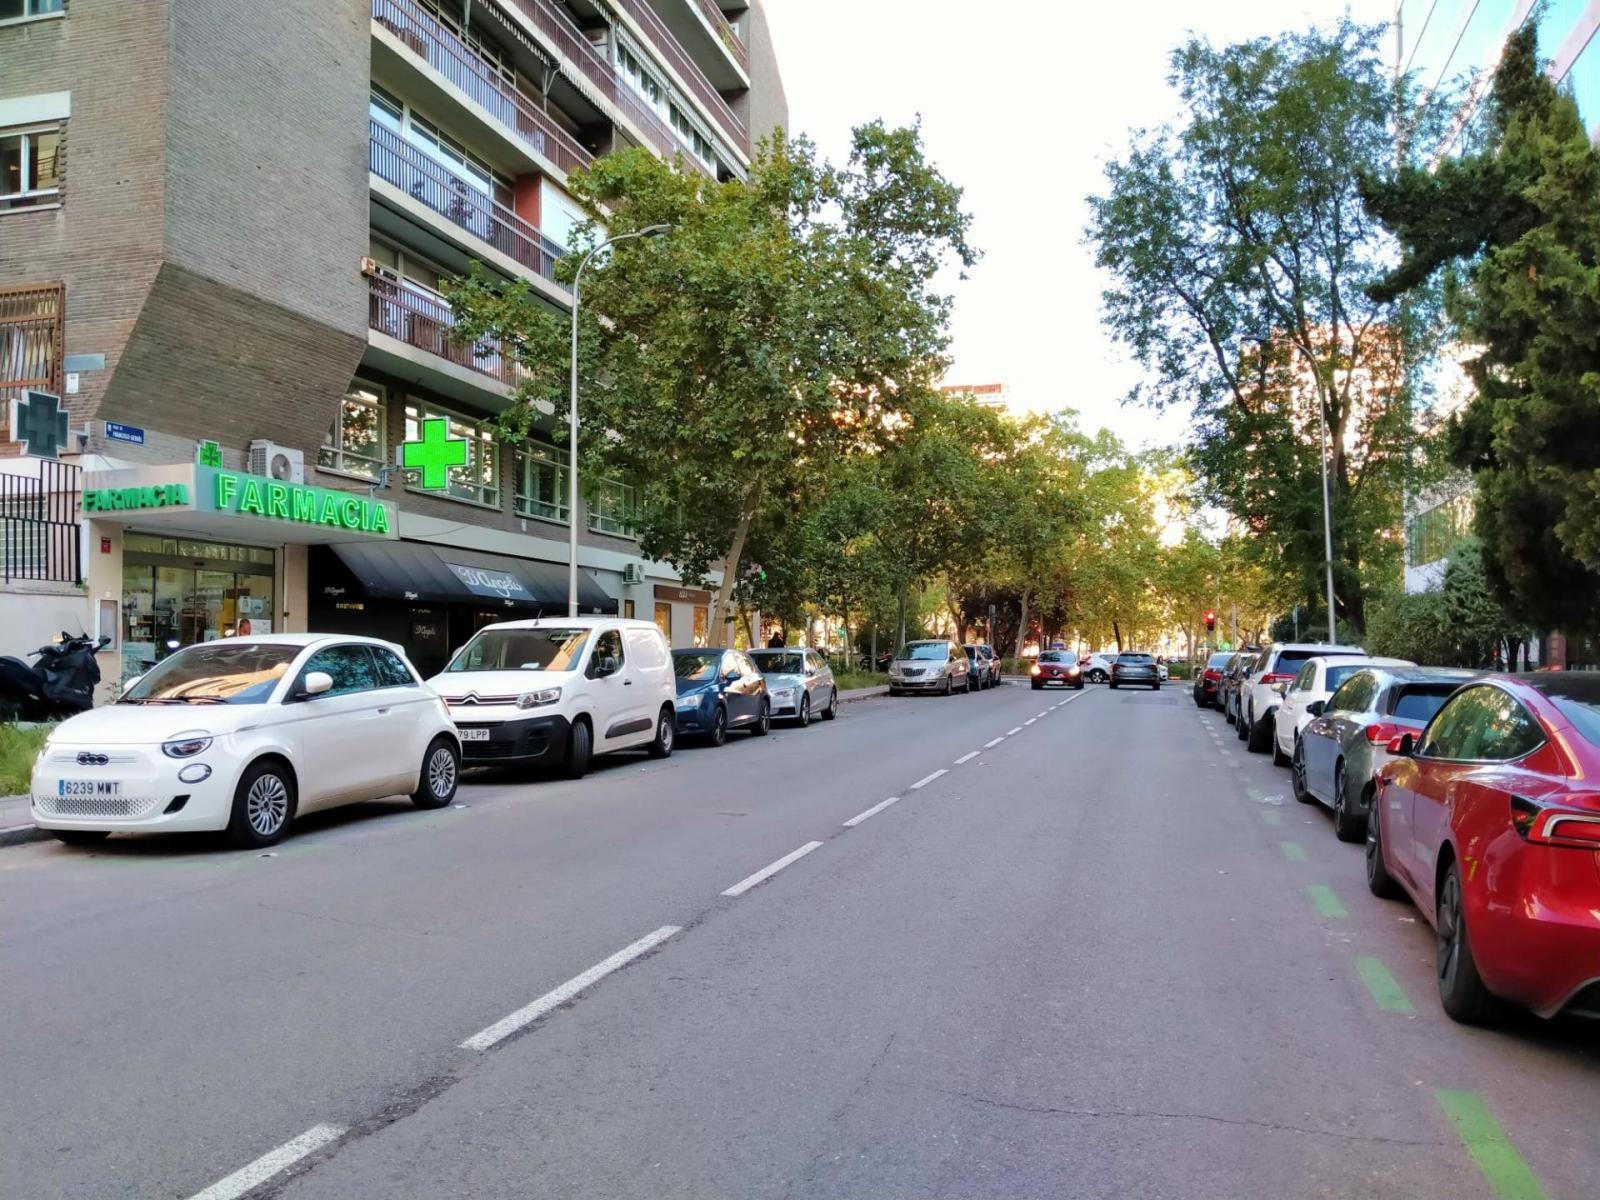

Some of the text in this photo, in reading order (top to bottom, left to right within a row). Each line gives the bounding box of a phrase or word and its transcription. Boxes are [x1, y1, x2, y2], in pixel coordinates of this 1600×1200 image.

[83, 484, 188, 512] FARMACIA
[217, 473, 390, 533] FARMACIA
[471, 730, 488, 739] LPP
[66, 782, 94, 794] 6239
